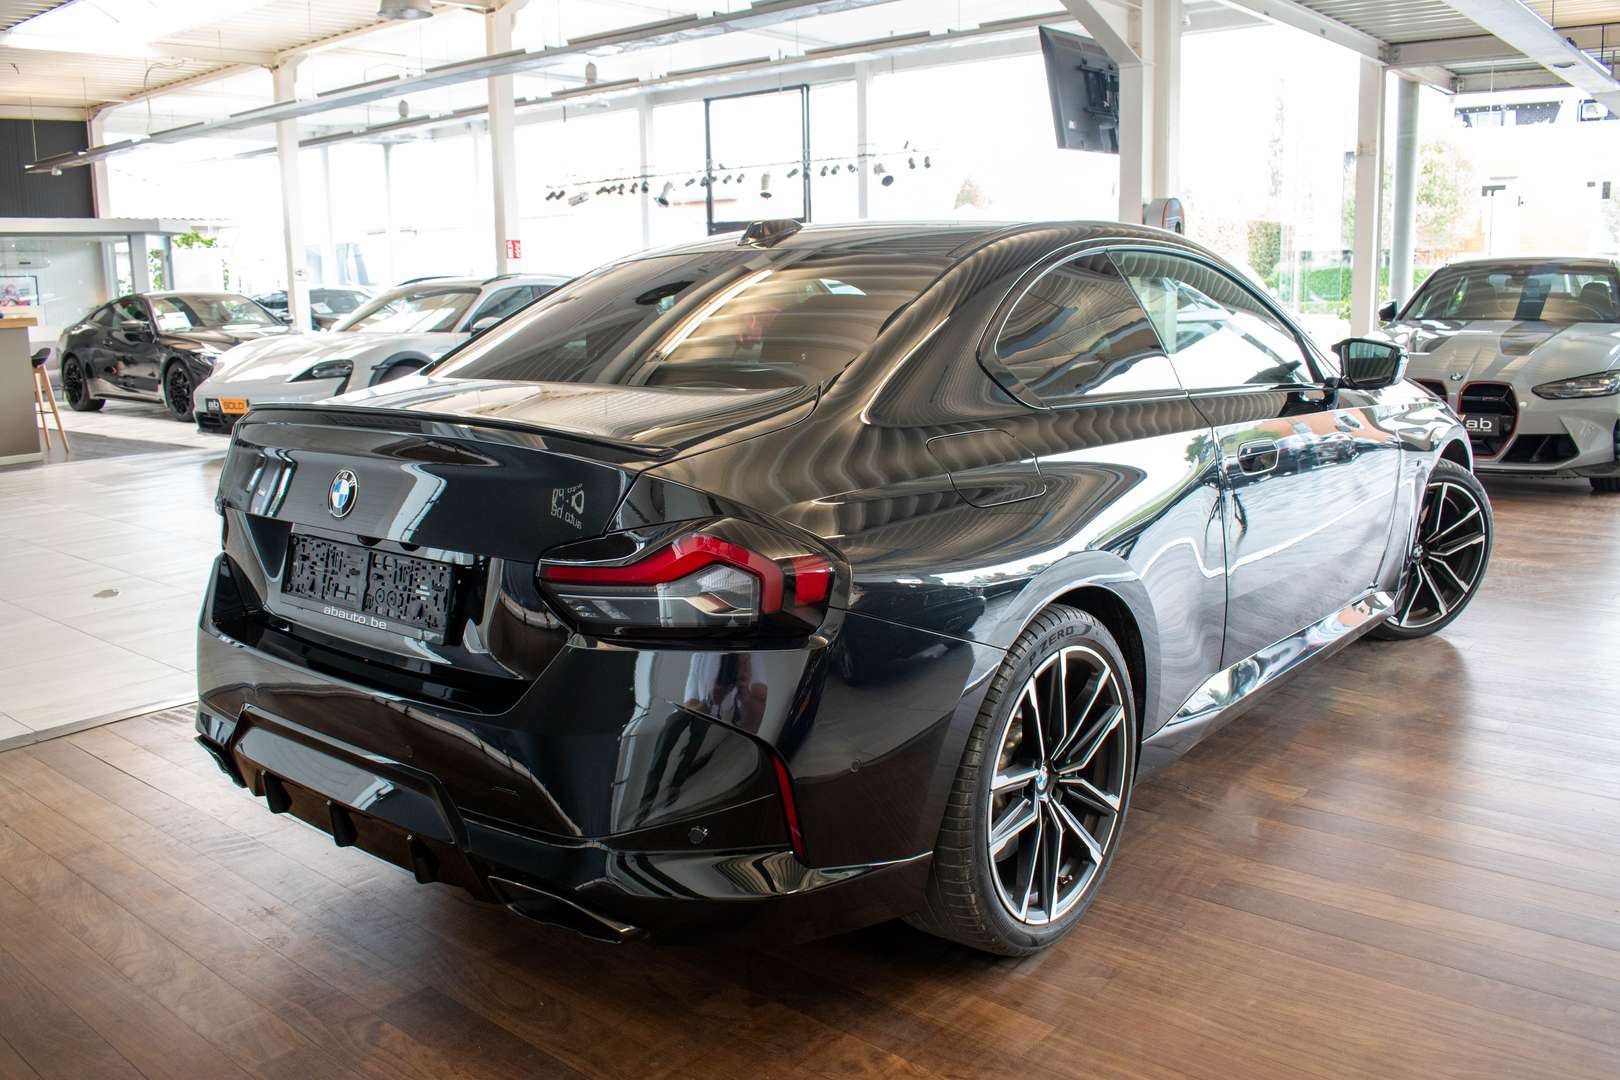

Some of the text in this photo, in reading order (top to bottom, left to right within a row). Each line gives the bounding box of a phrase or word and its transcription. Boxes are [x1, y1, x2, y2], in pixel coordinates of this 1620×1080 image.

[1465, 417, 1492, 429] ab
[323, 606, 387, 629] abauto.be
[1040, 626, 1074, 653] ZERO
